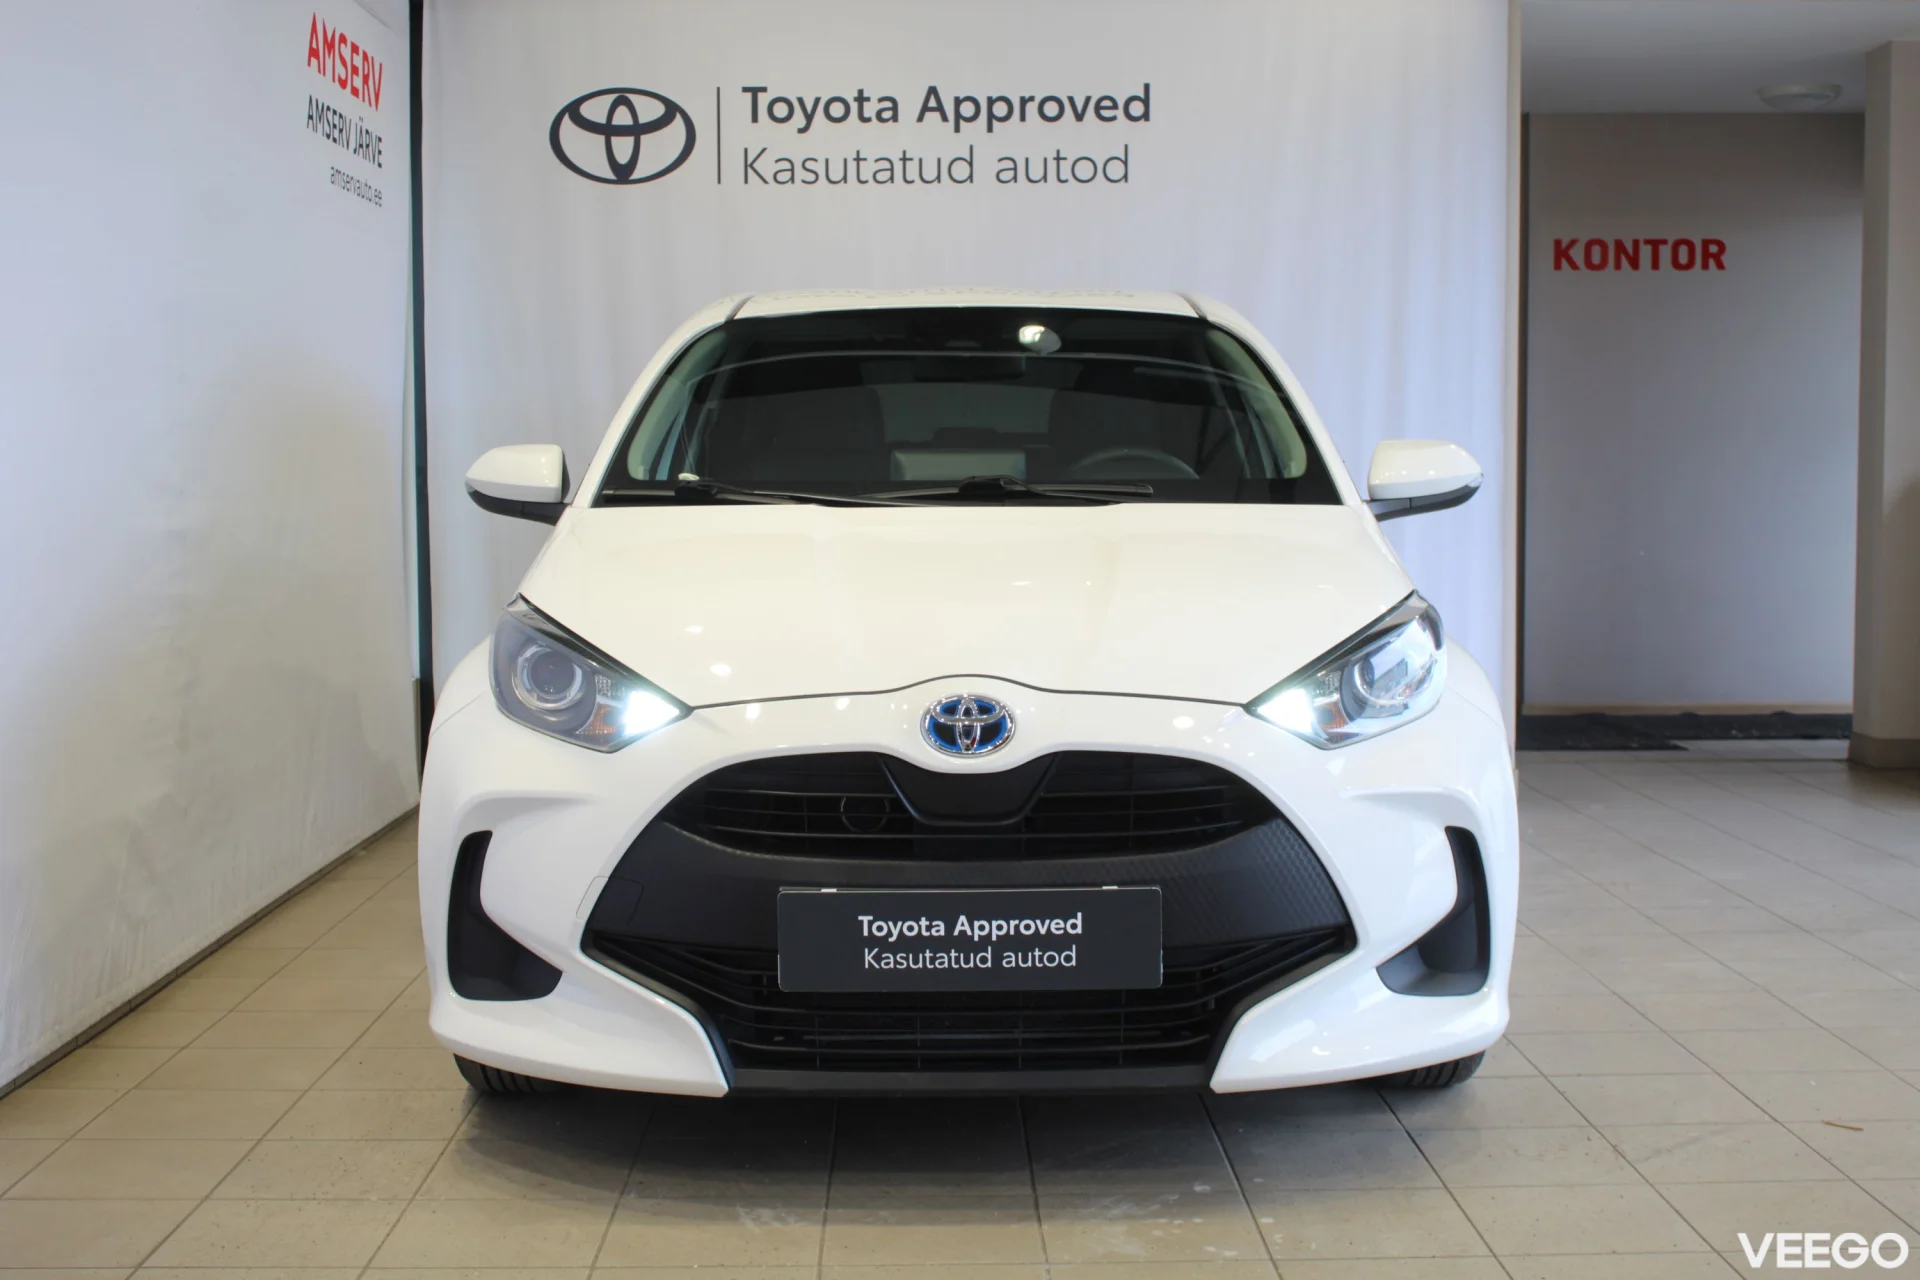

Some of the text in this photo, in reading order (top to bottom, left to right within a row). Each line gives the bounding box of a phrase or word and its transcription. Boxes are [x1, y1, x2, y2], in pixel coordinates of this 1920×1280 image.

[307, 12, 383, 112] AMSERV
[742, 83, 1151, 133] Toyota Approved
[306, 95, 383, 169] AMSERV JÄRVE
[742, 144, 1129, 184] Kasutatud autod
[330, 166, 383, 207] amservauto.ee
[1553, 238, 1727, 271] KONTOR
[858, 912, 1083, 942] Toyota Approved
[864, 944, 1076, 969] Kasutatud autod
